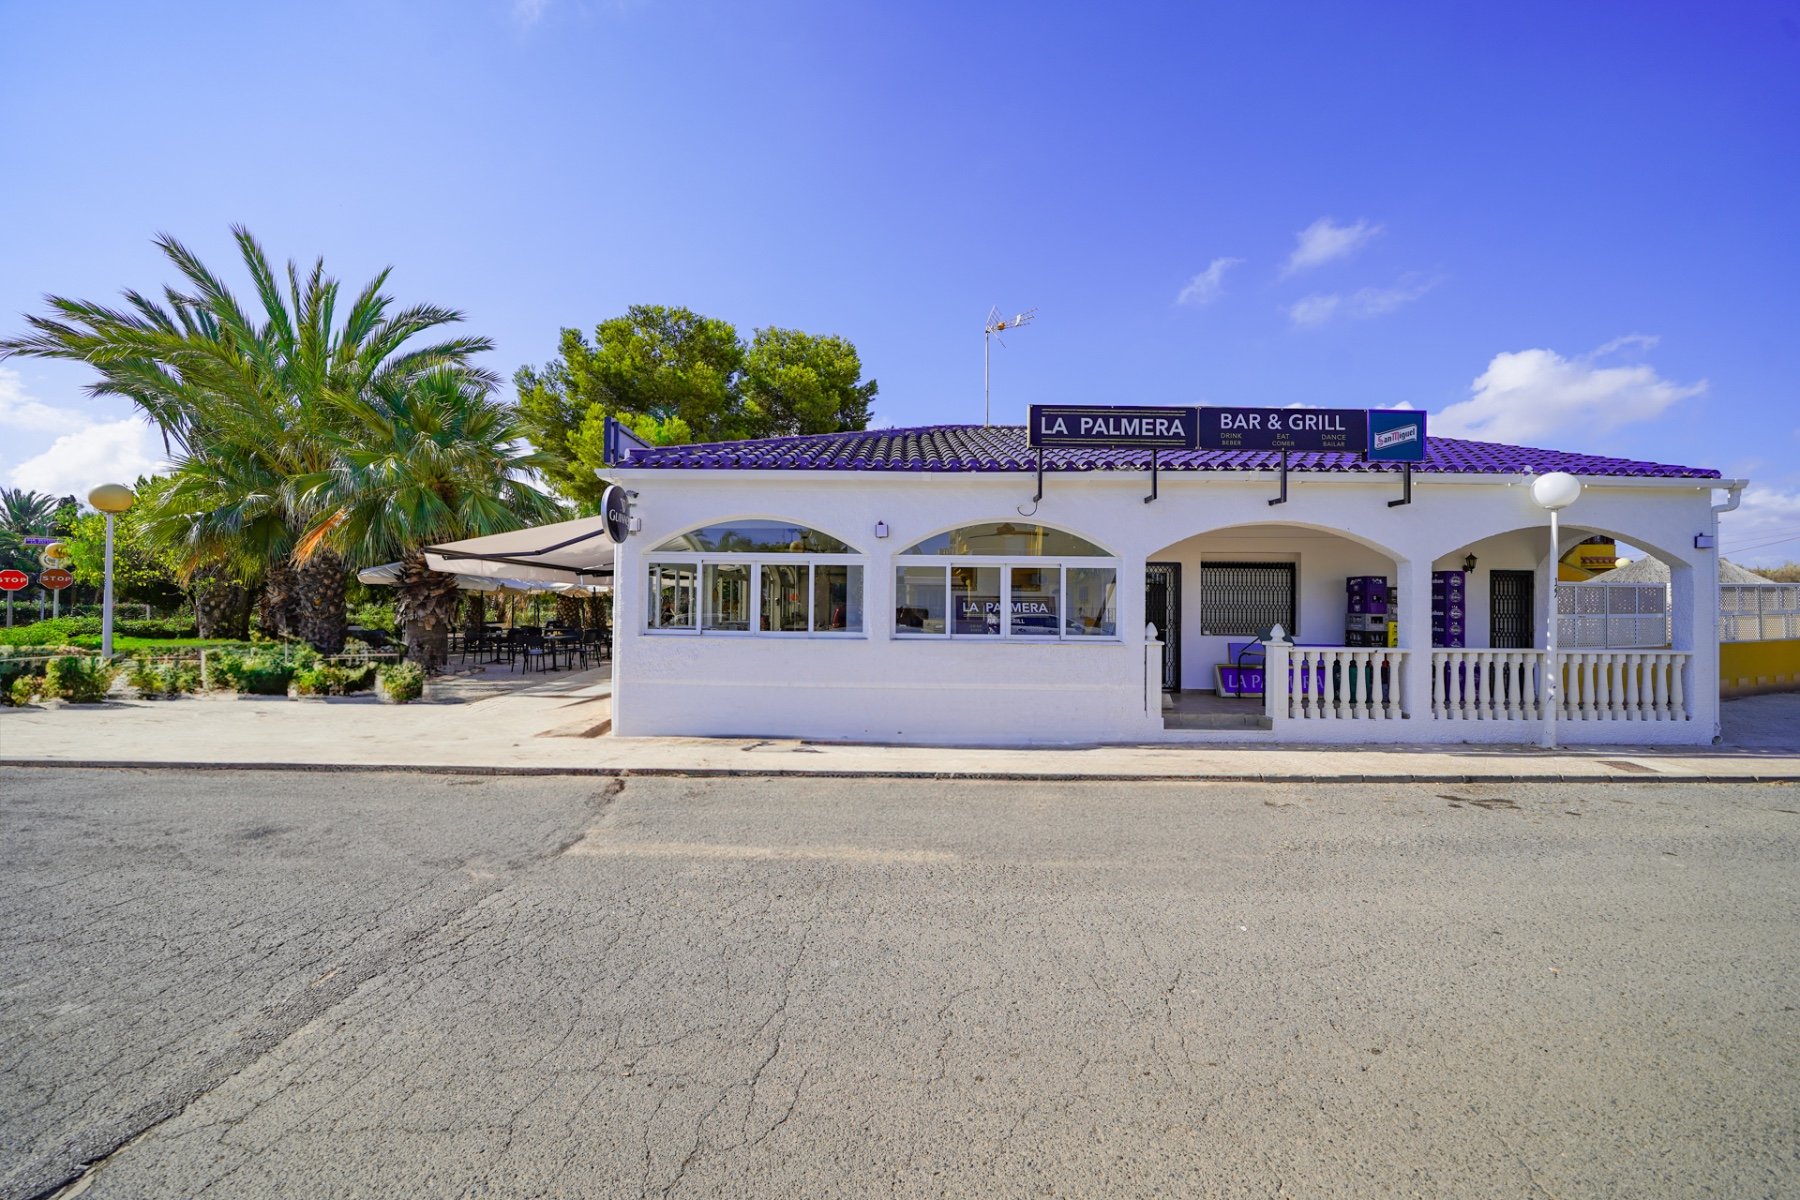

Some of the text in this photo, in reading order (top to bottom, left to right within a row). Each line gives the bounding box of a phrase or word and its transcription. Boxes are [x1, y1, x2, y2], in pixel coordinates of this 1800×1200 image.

[1041, 417, 1185, 436] LA PALMERA
[1220, 413, 1346, 431] BAR & GRILL
[963, 602, 1048, 613] LA PAMERA
